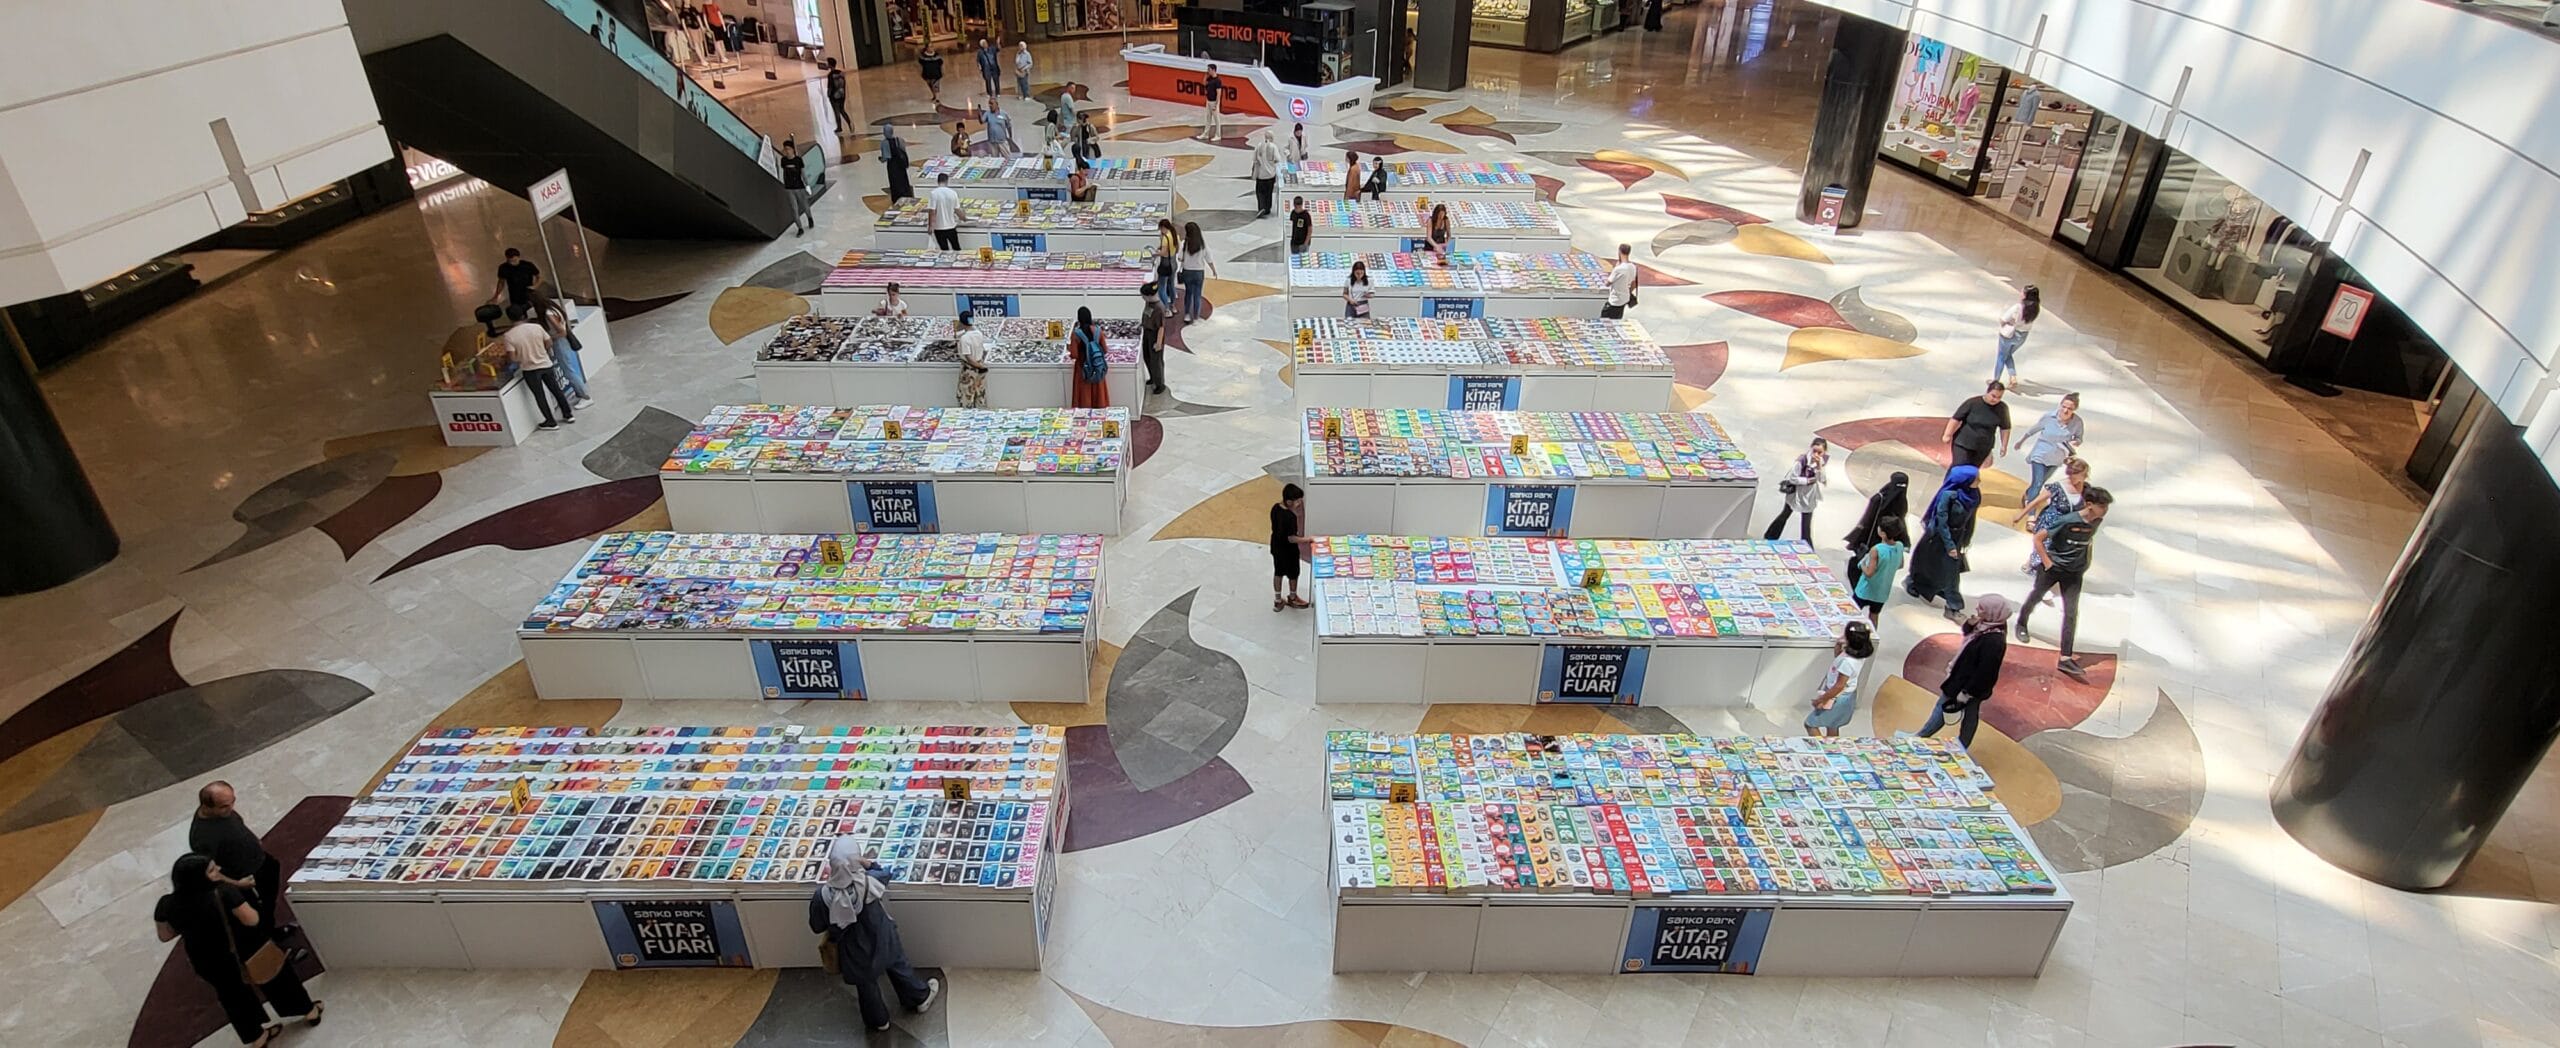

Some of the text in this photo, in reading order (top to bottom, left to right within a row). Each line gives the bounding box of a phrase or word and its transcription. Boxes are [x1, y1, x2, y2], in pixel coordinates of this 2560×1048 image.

[541, 181, 562, 200] KASA
[972, 306, 1003, 318] KİTAP
[2337, 297, 2358, 320] 70
[1465, 388, 1501, 401] KİTAP
[888, 431, 898, 439] 25
[1327, 429, 1337, 437] 25
[1514, 446, 1524, 454] 25
[871, 496, 913, 510] KİTAP
[1507, 499, 1550, 514] KİTAP
[828, 551, 839, 561] 15
[781, 656, 834, 673] KİTAP
[1566, 662, 1618, 678] KİTAP
[637, 919, 706, 938] KİTAP
[1661, 926, 1729, 944] KİTAP
